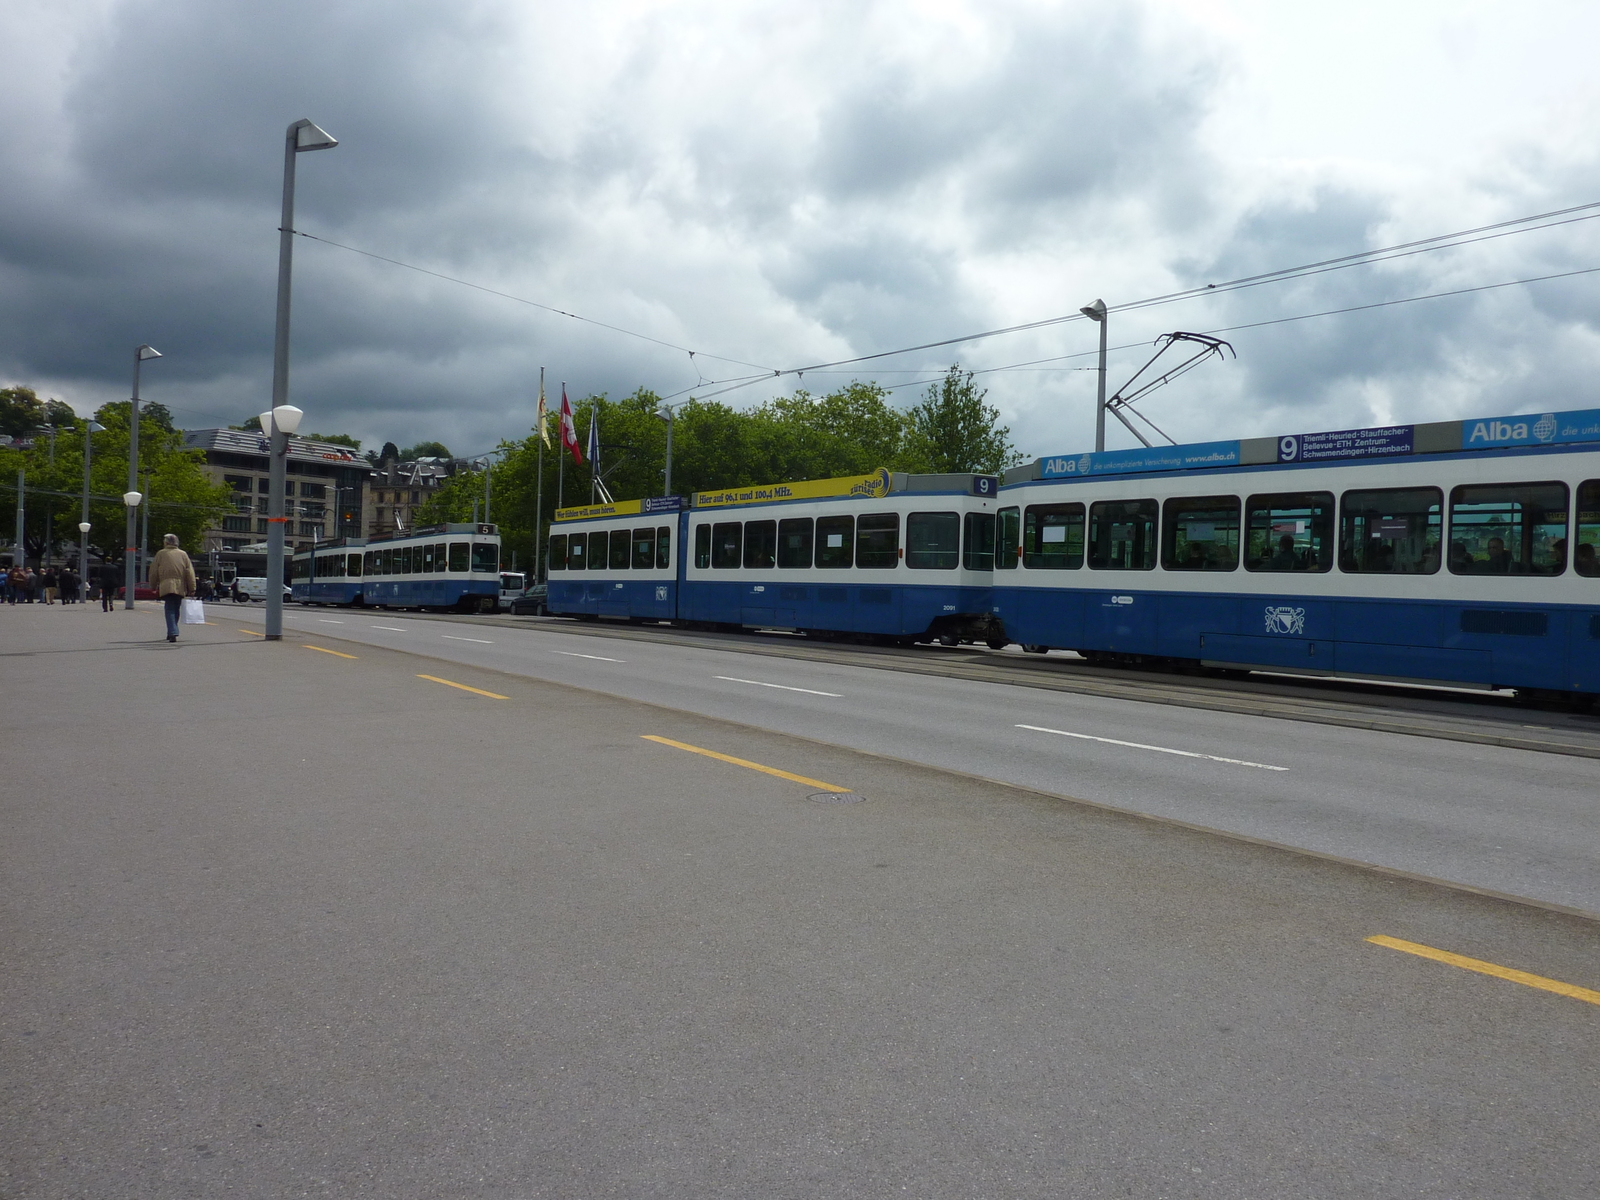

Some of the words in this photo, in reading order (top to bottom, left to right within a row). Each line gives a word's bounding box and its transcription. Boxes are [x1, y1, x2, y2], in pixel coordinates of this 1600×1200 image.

[1469, 421, 1527, 443] Alba
[1562, 425, 1577, 436] die
[1280, 436, 1298, 461] 9
[1303, 440, 1352, 450] Bellevue-ETH
[1355, 438, 1390, 447] Zentrum-
[1185, 452, 1236, 463] www.alba.ch
[1303, 444, 1410, 459] Schwamendingen-Hirzenbach
[1045, 459, 1075, 474] Alba
[1104, 461, 1143, 470] unkomplizierte
[1144, 457, 1182, 466] Versicherung
[864, 478, 882, 489] radio
[980, 478, 989, 493] 9
[699, 494, 712, 504] Hier
[713, 494, 724, 502] auf
[740, 490, 752, 500] und
[774, 487, 792, 497] MHz.
[645, 498, 652, 512] 9
[482, 525, 489, 534] 5
